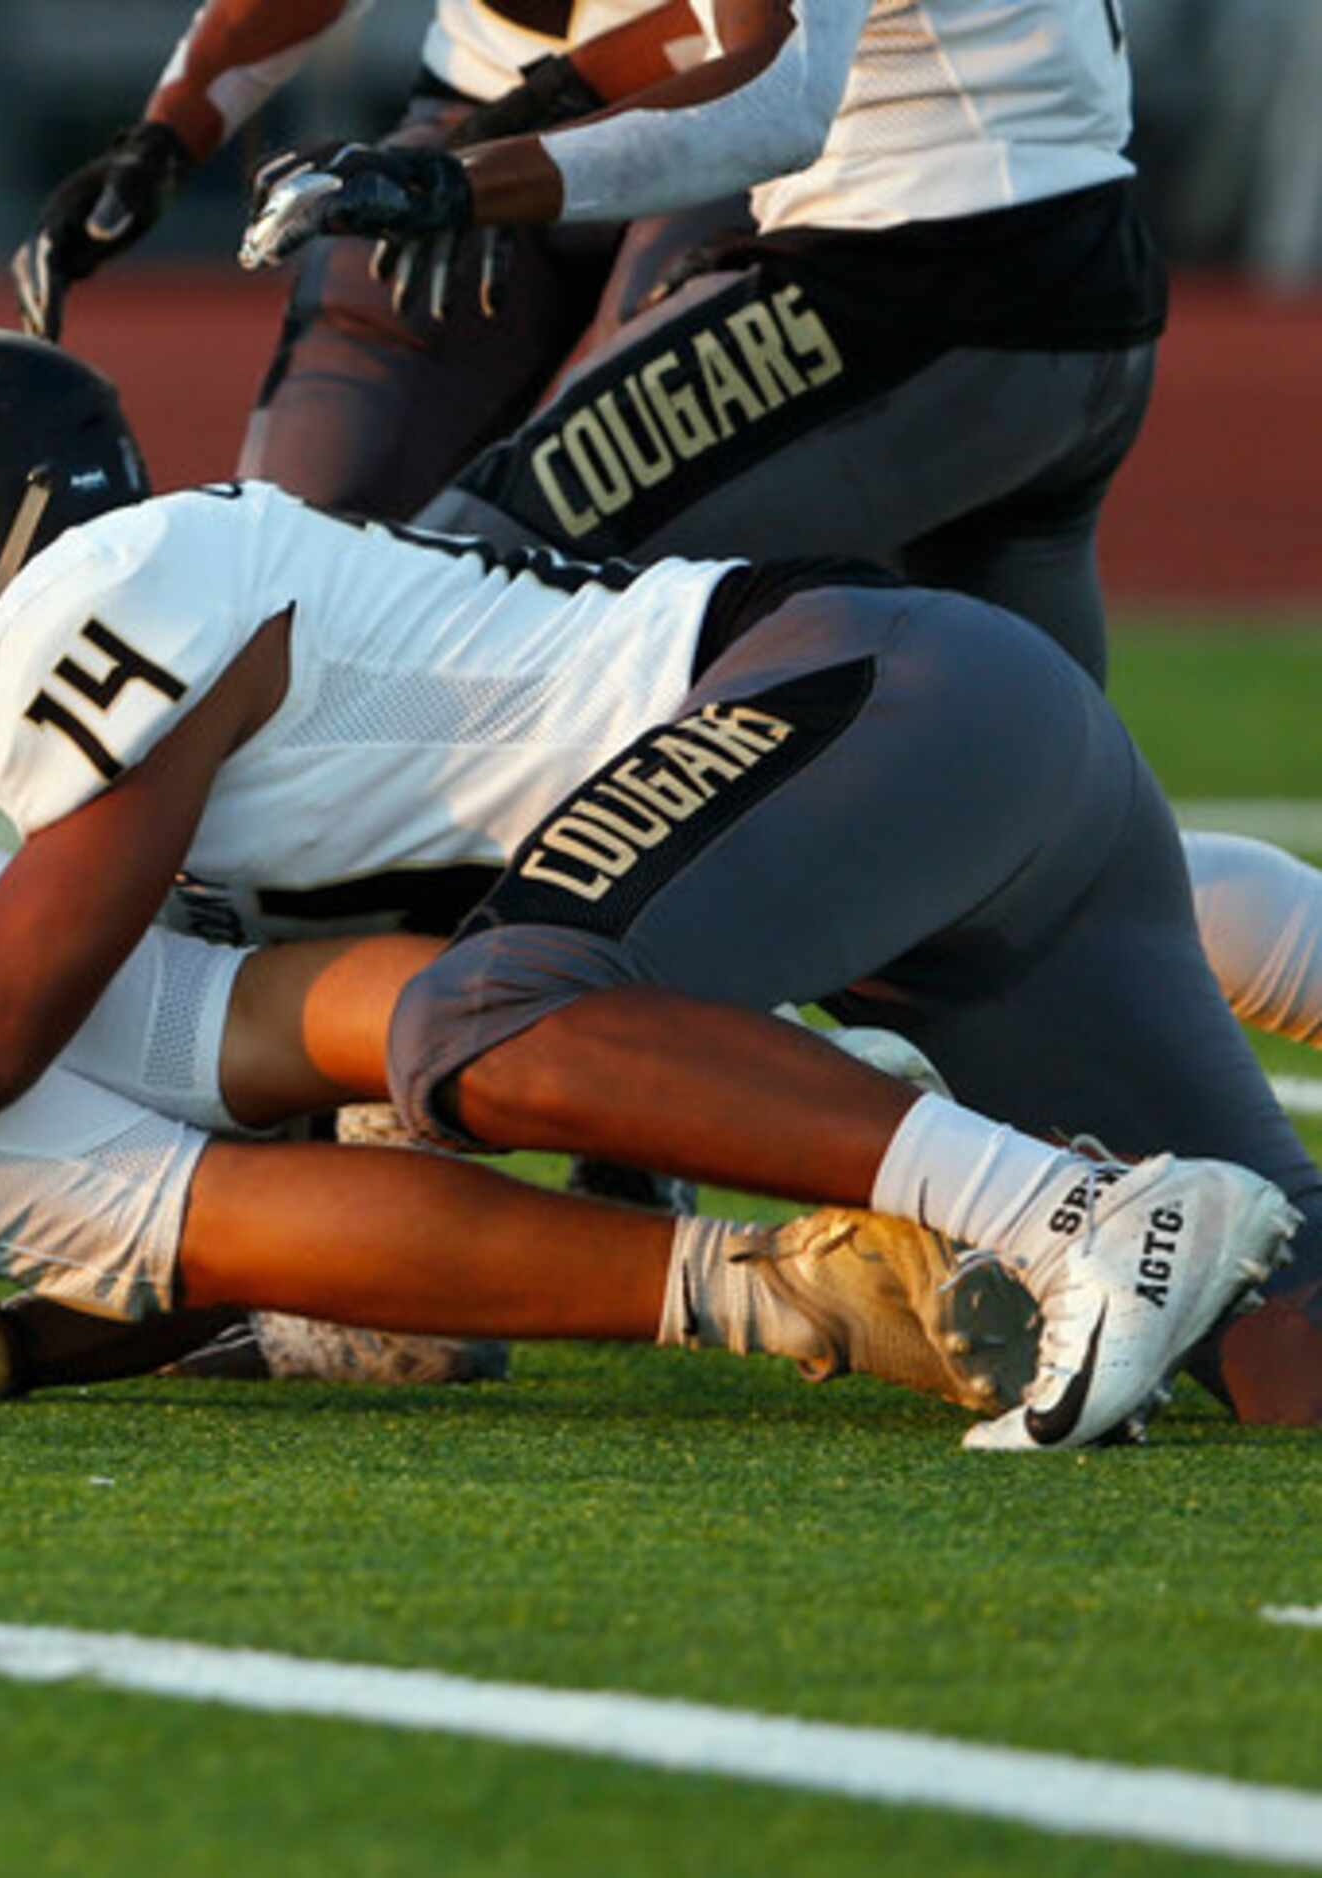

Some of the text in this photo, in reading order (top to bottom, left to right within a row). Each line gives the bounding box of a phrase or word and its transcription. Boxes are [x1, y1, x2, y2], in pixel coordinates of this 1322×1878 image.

[530, 283, 845, 538] COUGARS
[25, 618, 188, 782] 14
[519, 702, 795, 902] COUGARS
[1135, 1206, 1184, 1310] AGTG
